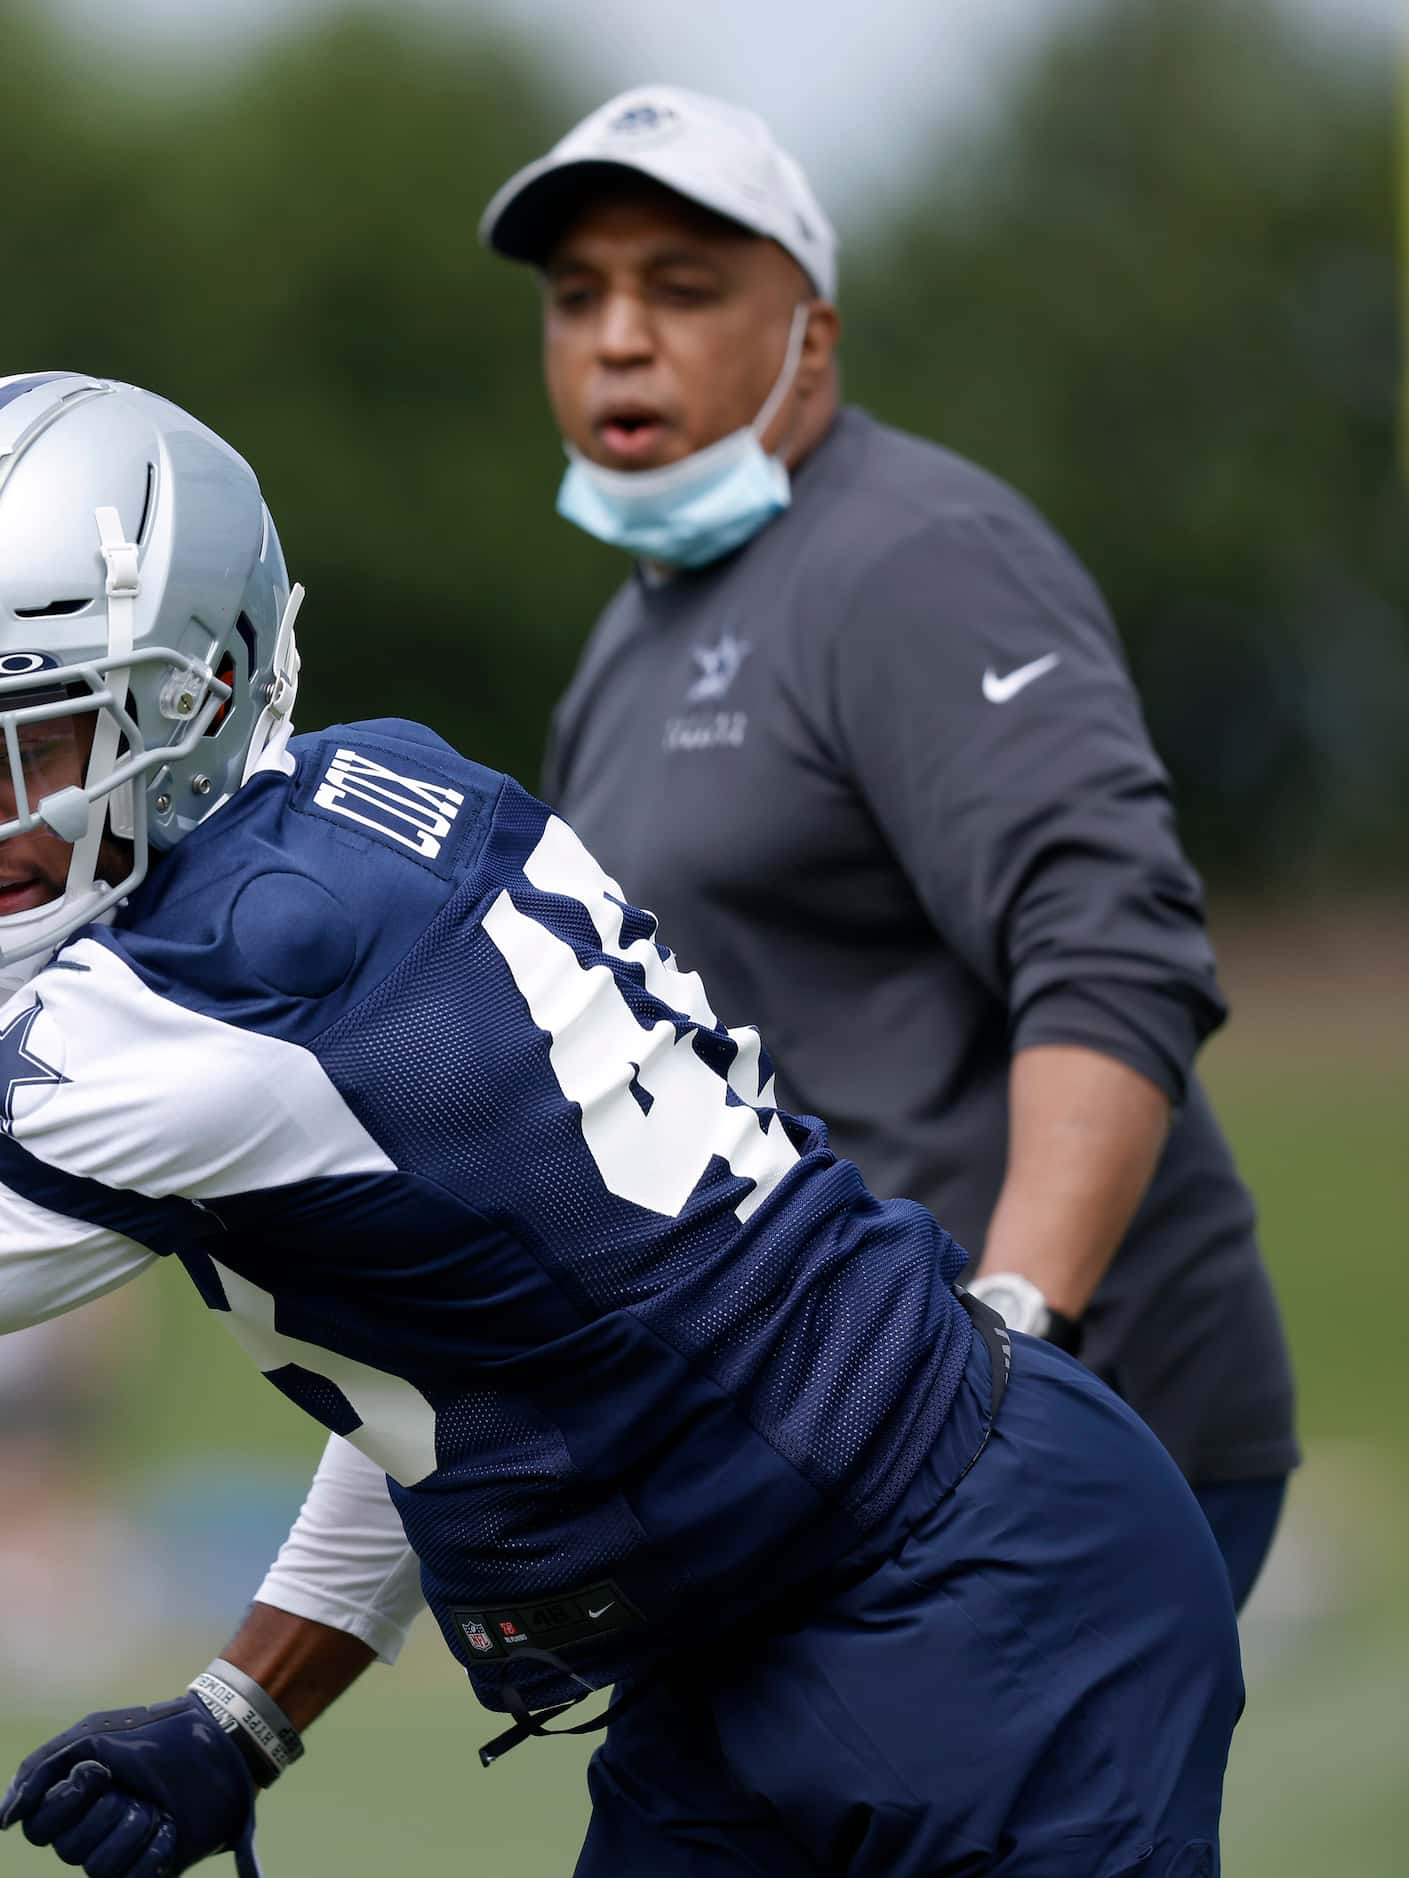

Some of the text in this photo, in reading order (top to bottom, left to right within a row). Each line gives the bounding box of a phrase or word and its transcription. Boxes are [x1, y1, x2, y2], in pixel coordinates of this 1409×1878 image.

[313, 749, 465, 859] COX
[471, 1633, 490, 1646] NFL
[242, 1710, 275, 1745] HYPE
